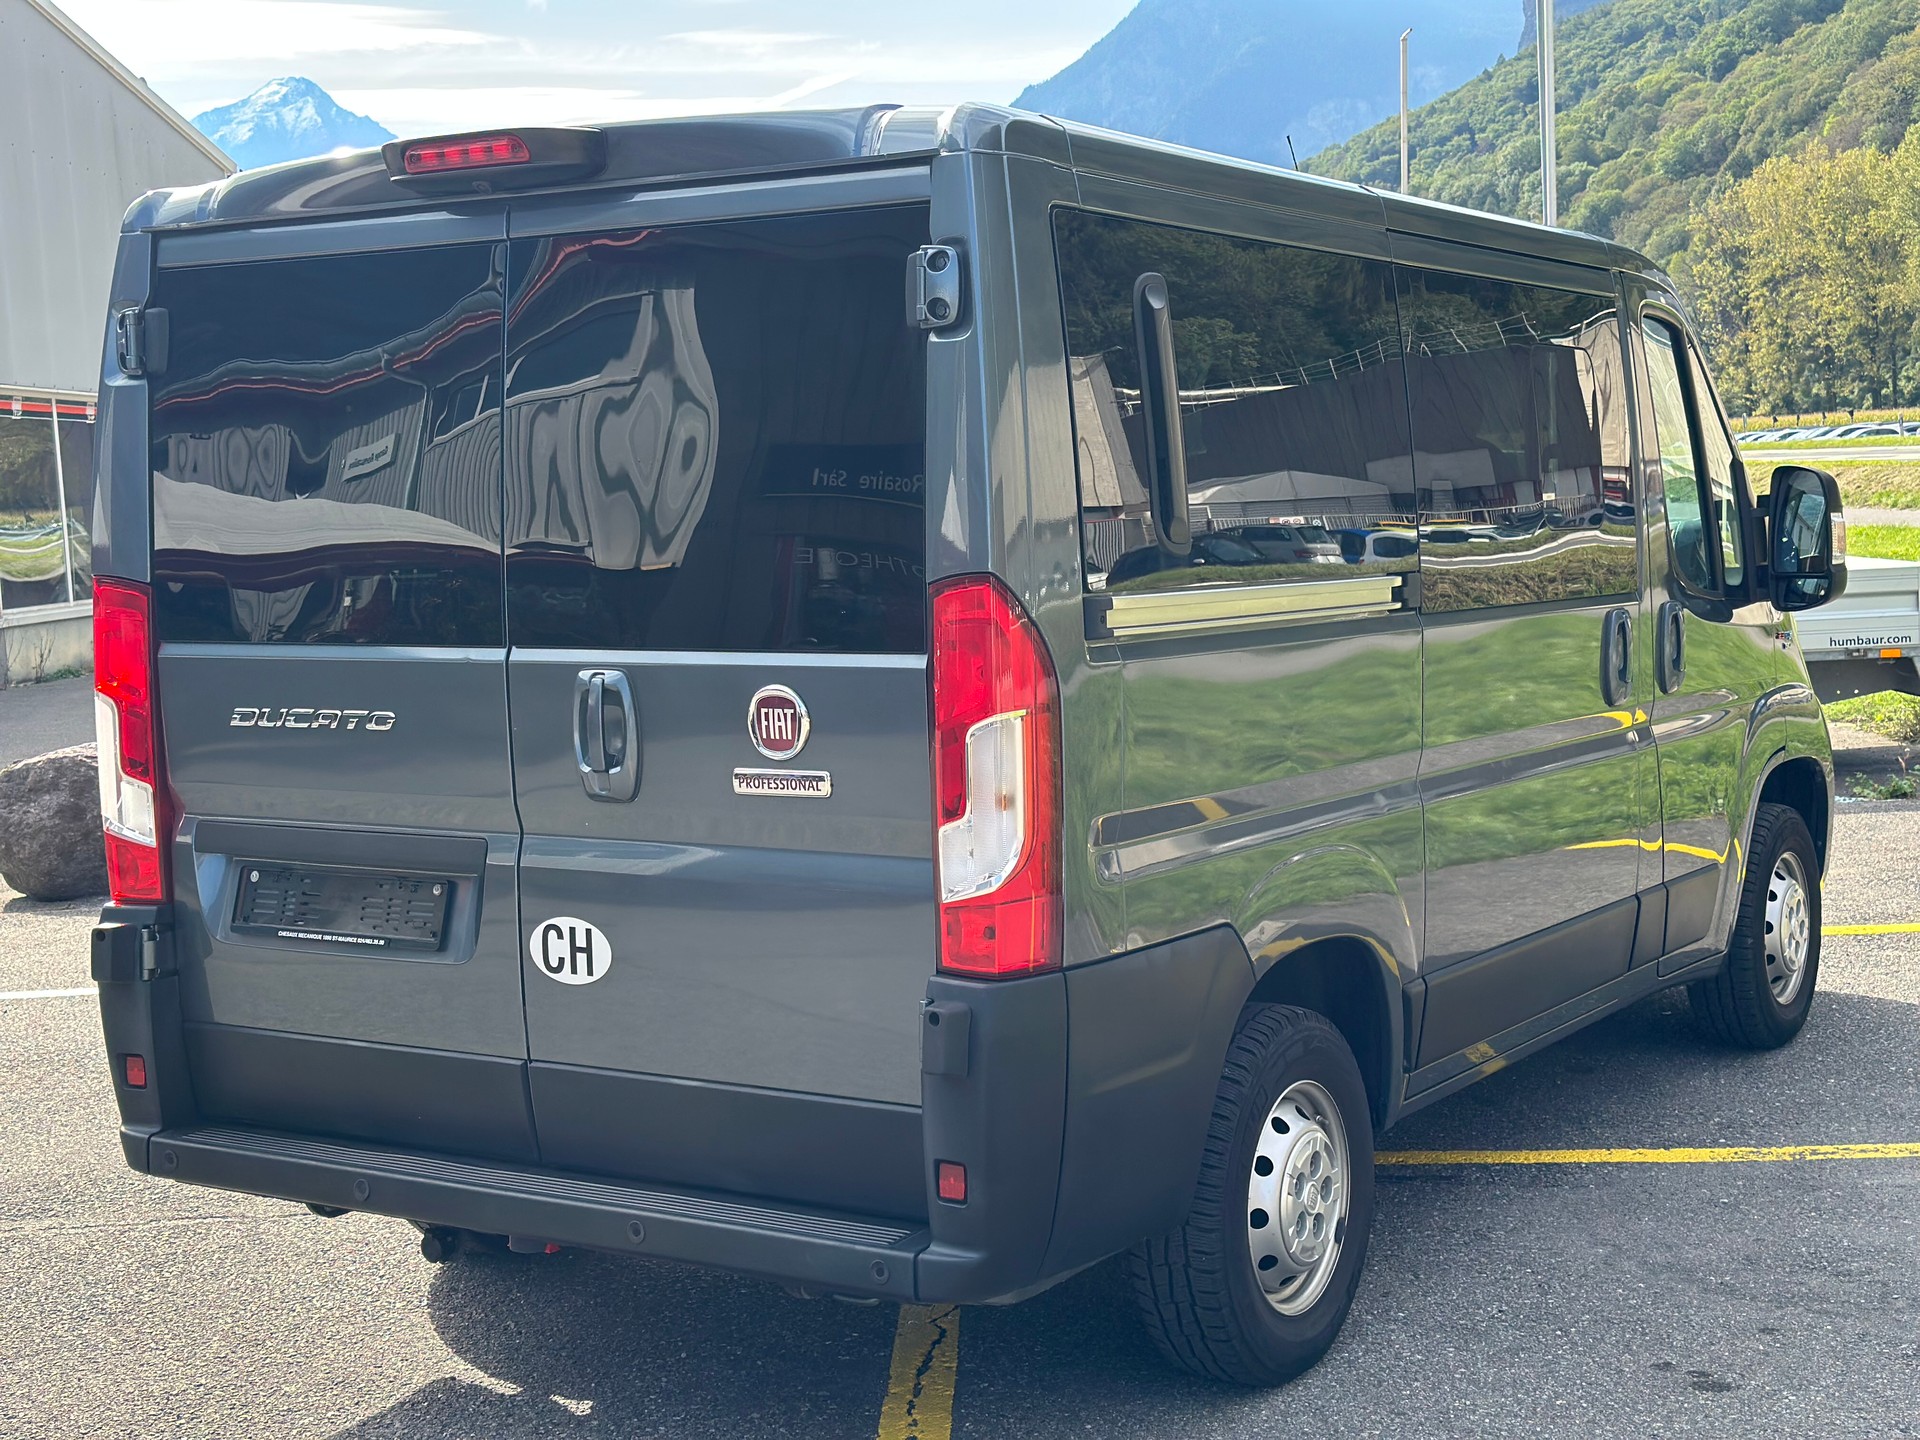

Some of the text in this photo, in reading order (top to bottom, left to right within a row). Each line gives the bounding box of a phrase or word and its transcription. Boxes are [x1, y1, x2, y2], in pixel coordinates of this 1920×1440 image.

[1829, 635, 1912, 647] humbaur.com
[230, 707, 396, 731] DUCATO
[760, 707, 795, 740] FIAT
[738, 775, 822, 792] PROFESSIONAL
[542, 923, 594, 977] CH
